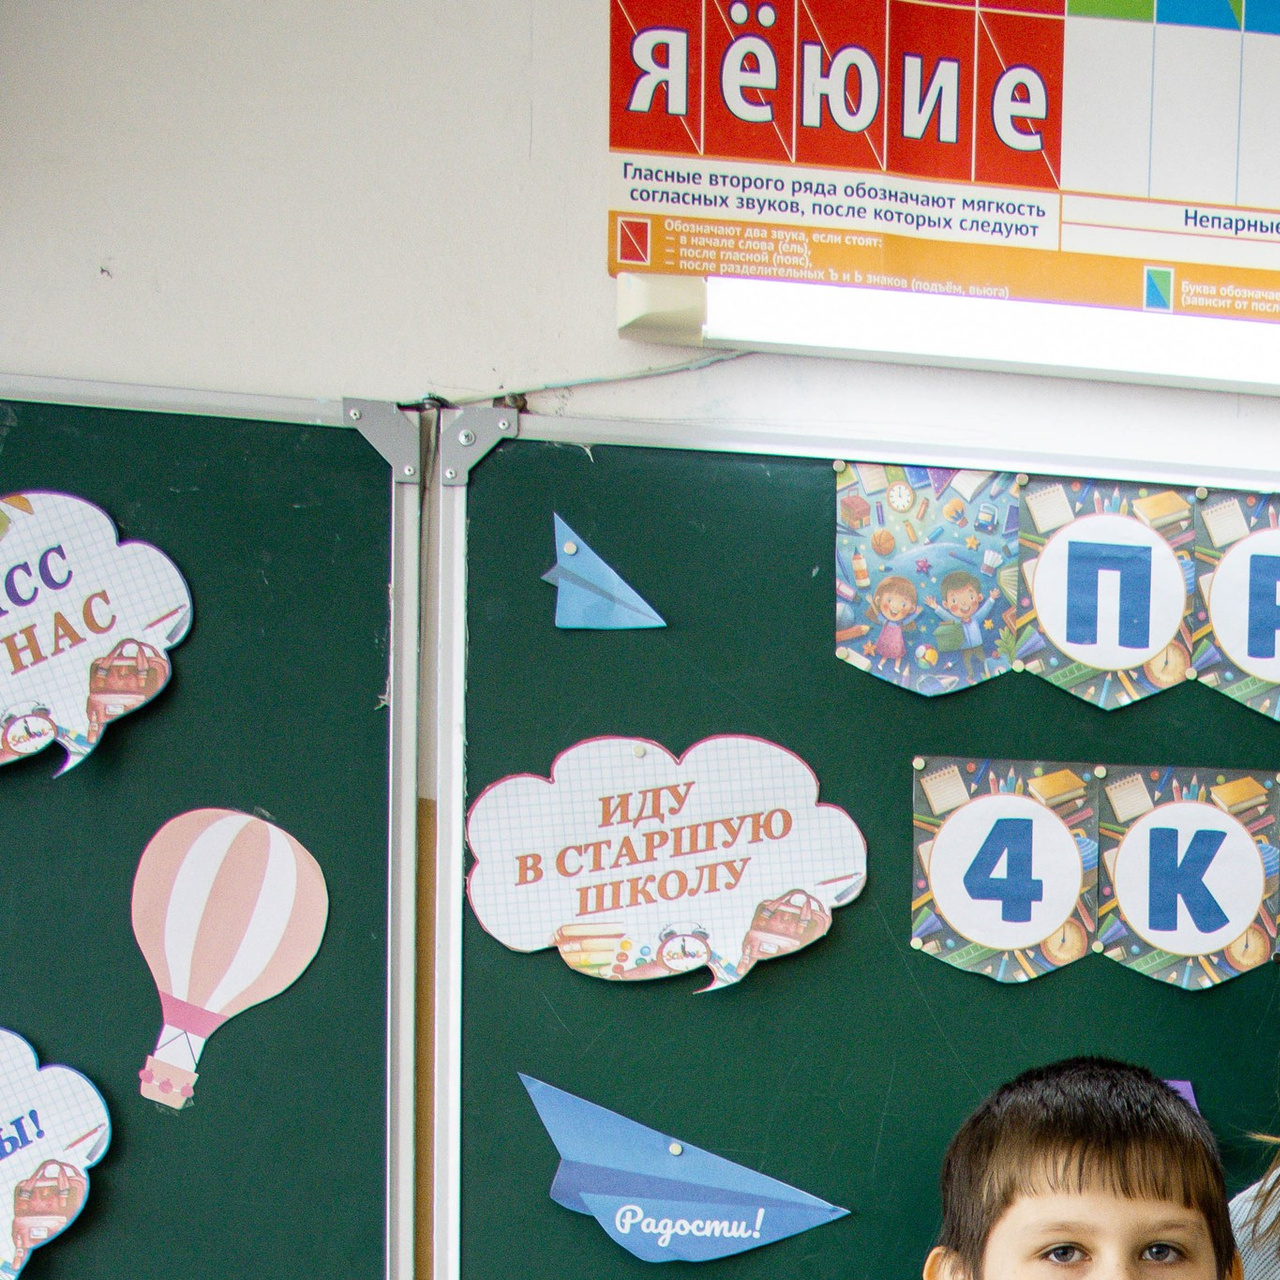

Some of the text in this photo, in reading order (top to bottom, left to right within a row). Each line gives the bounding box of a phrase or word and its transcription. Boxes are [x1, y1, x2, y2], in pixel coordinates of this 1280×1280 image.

[623, 162, 1046, 218] Гласные второго ряда обозначают мягкость
[630, 187, 1039, 239] согласных звуков, после которых следуют
[664, 218, 885, 248] Обозначают два звука, если стоят:
[679, 235, 687, 245] в
[691, 237, 735, 249] начале
[738, 240, 775, 252] слова
[679, 248, 717, 260] после
[720, 250, 769, 264] гласной
[772, 254, 813, 268] (пояс),
[679, 260, 717, 272] после
[719, 262, 825, 281] разделительных
[841, 271, 850, 281] и
[866, 274, 908, 288] знаков
[1181, 280, 1217, 296] Буква
[1181, 294, 1232, 310] (зависит
[1235, 299, 1249, 310] от
[0, 544, 73, 617] СС
[0, 590, 117, 675] НАС
[598, 781, 696, 828] ИДУ
[515, 808, 793, 886] В СТАРШУЮ
[575, 857, 752, 917] ШКОЛУ
[615, 1205, 765, 1247] Радости!
